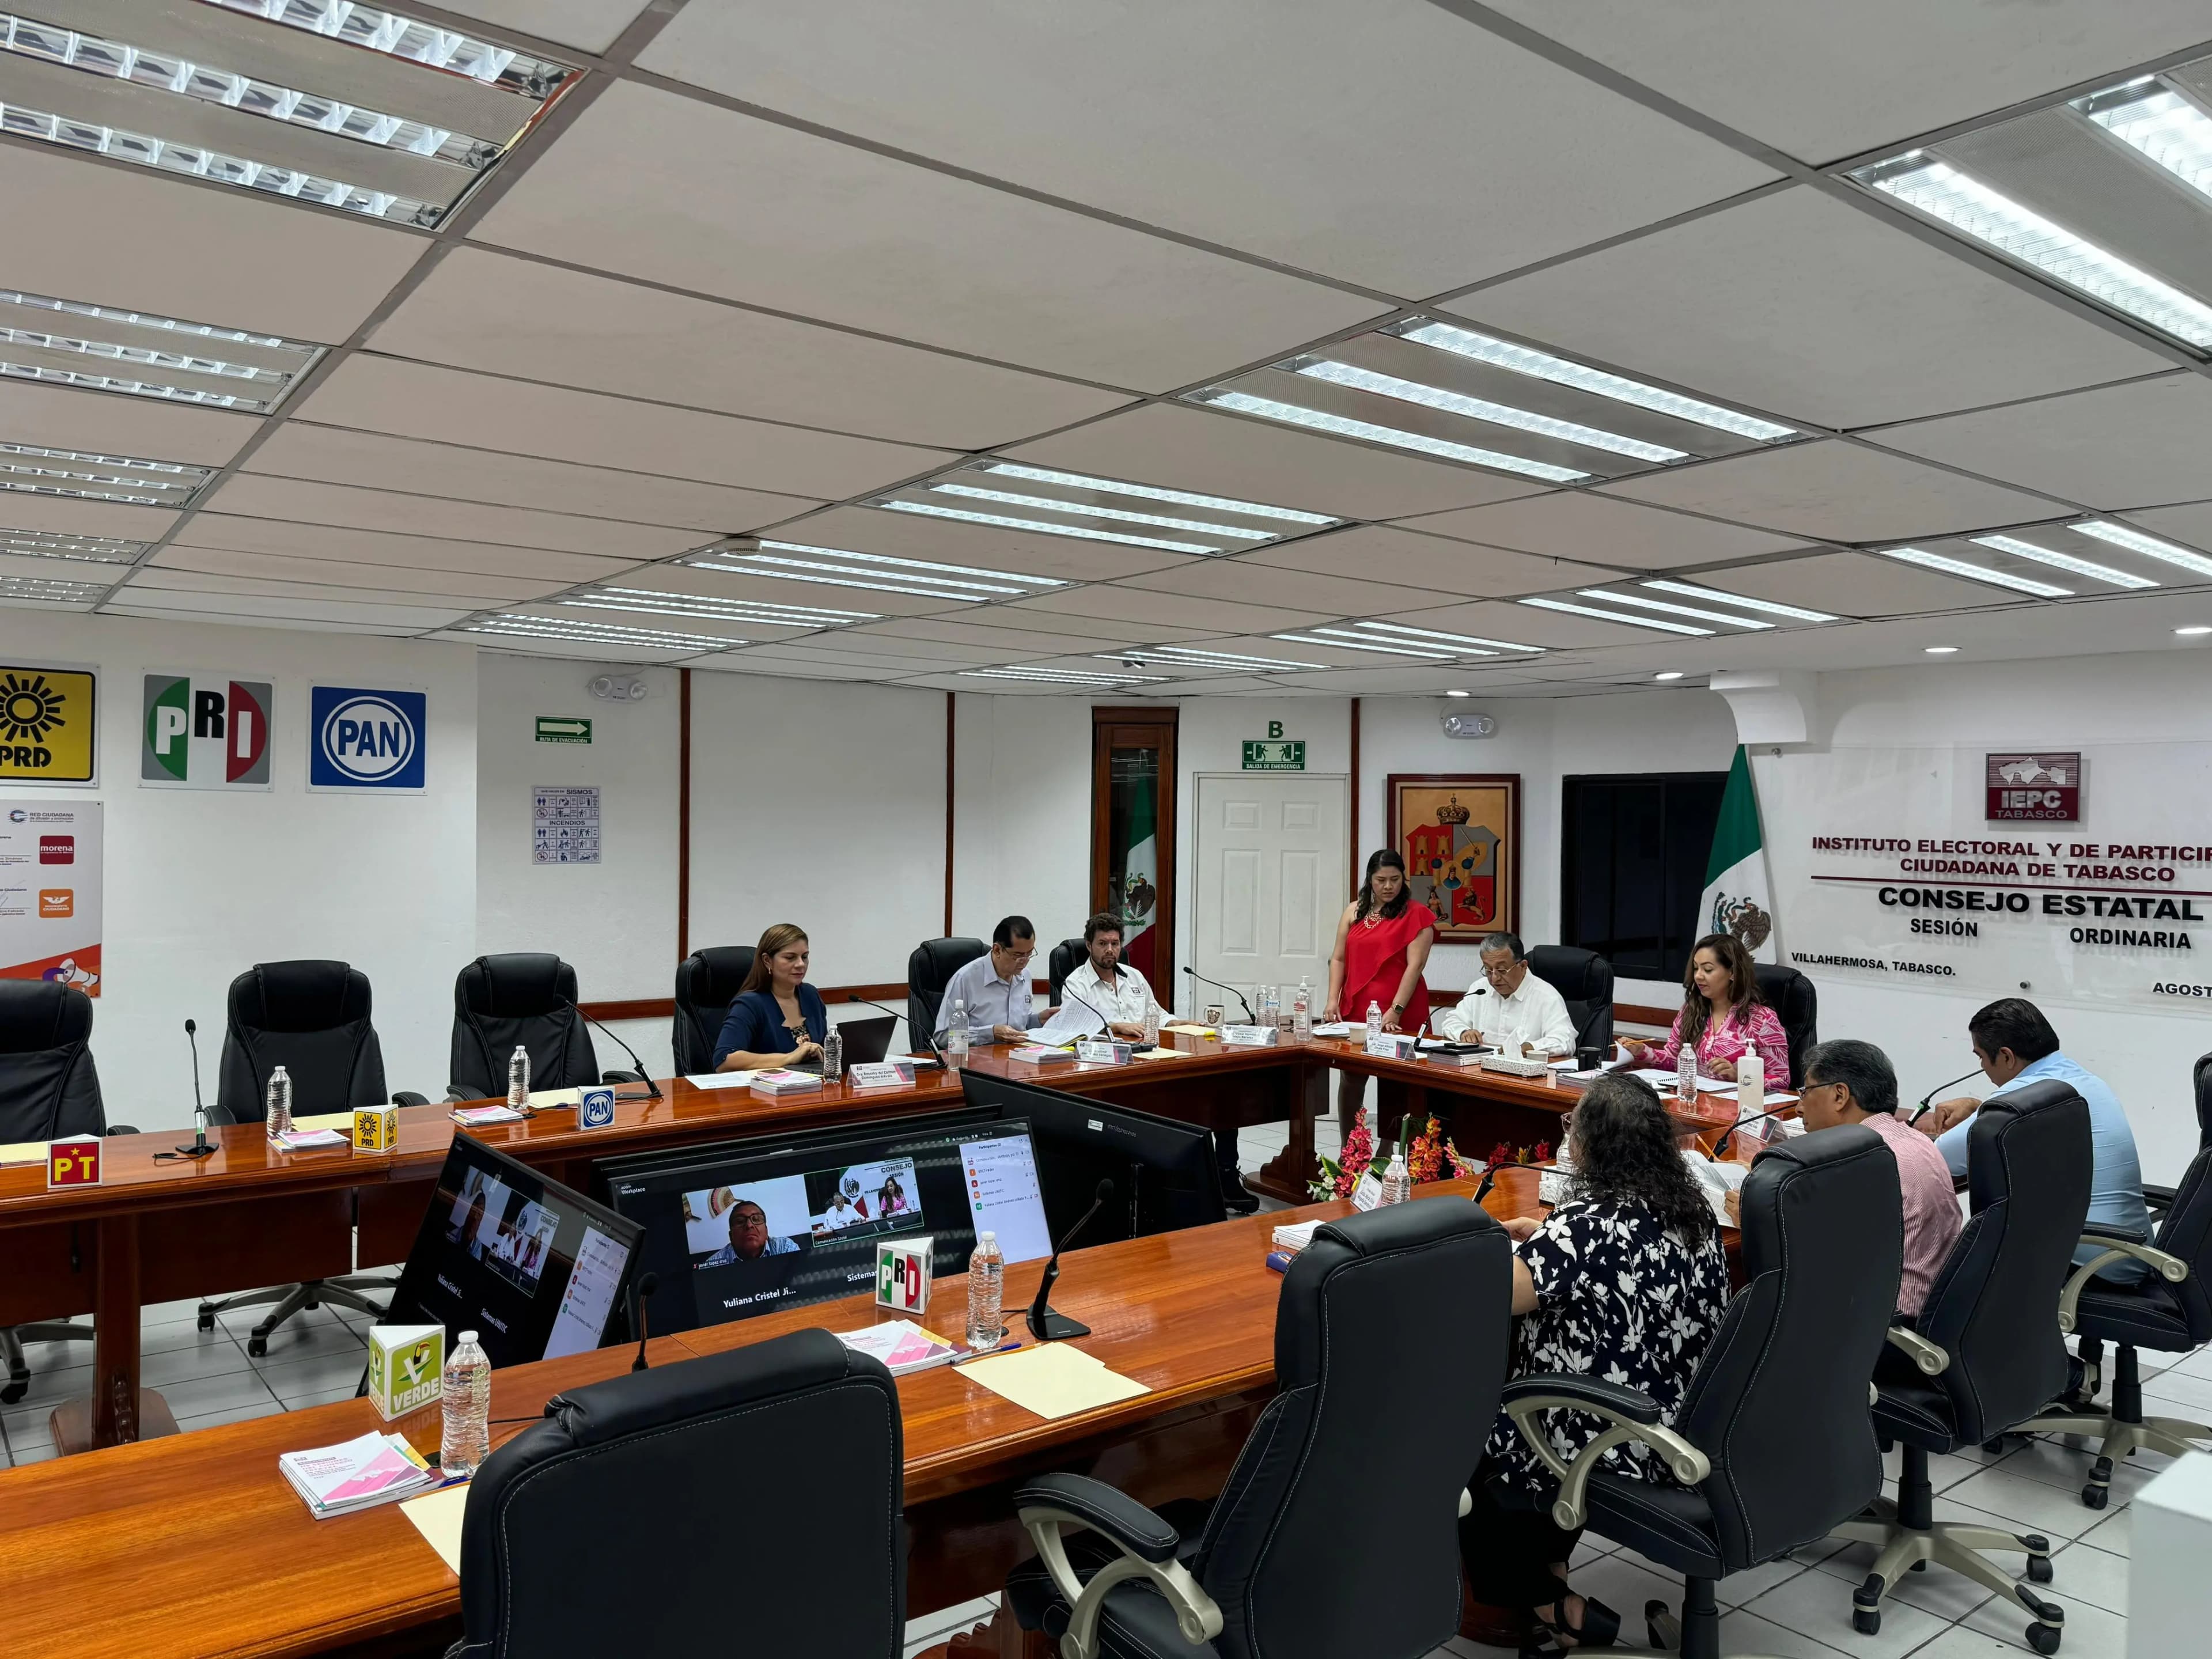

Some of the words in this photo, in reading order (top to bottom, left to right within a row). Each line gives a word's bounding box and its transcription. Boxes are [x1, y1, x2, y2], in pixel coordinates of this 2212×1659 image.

[156, 690, 252, 758] PRI
[1268, 721, 1283, 738] B
[338, 719, 400, 757] PAN
[0, 745, 51, 767] PRD
[2001, 790, 2062, 809] IEPC
[1995, 810, 2067, 819] TABASCO
[1812, 837, 1911, 852] INSTITUTO
[1917, 839, 2040, 856] ELECTORAL
[2047, 843, 2062, 857] Y
[2070, 844, 2100, 858] DE
[1900, 858, 2020, 876] CIUDADANA
[2027, 863, 2055, 877] DE
[2063, 864, 2175, 881] TABASCO
[1878, 887, 2030, 912] CONSEJO
[2043, 894, 2204, 921] ESTATAL
[1911, 918, 1978, 937] SESIÓN
[2070, 927, 2191, 949] ORDINARIA
[1791, 952, 1888, 971] VILLAHERMOSA,
[1892, 961, 1956, 976] TABASCO.
[2153, 982, 2212, 997] AGOST
[589, 1101, 608, 1117] PAN
[362, 1138, 374, 1146] PRD
[55, 1156, 94, 1181] PT
[881, 1162, 912, 1173] CONSEJO
[847, 1270, 878, 1282] Sistemas
[881, 1257, 915, 1296] PRI
[723, 1296, 753, 1308] Yuliana
[755, 1289, 780, 1302] Cristel
[393, 1377, 440, 1411] VERDE
